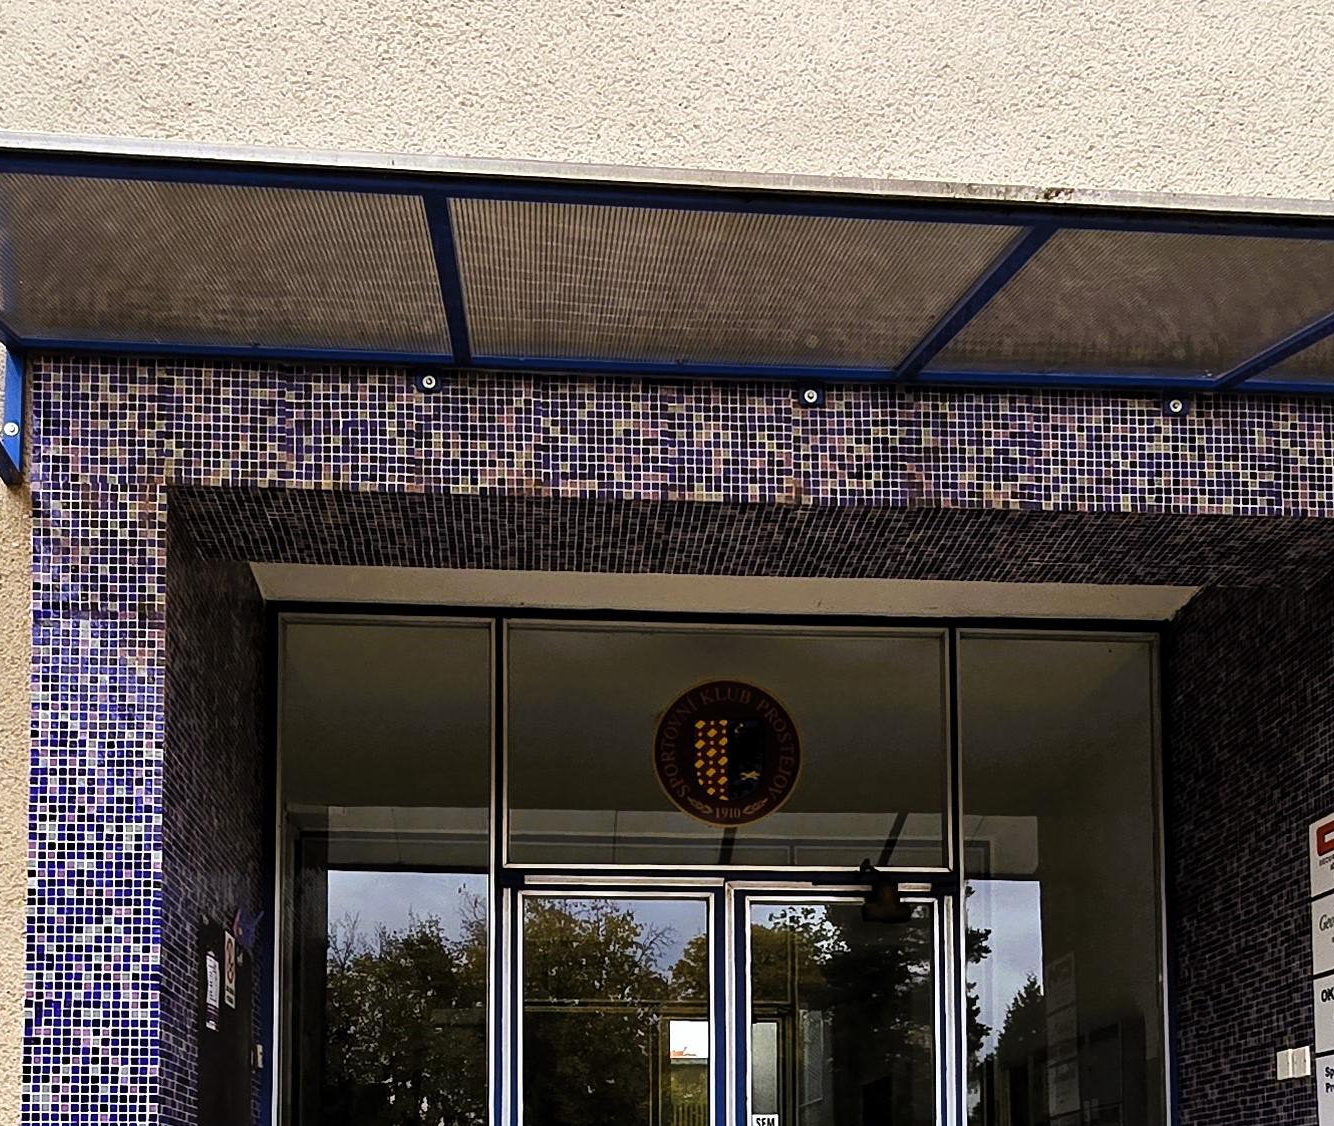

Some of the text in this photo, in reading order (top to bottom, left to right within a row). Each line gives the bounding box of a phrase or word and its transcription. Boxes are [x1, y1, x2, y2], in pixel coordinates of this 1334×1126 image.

[699, 687, 752, 705] KLUB
[715, 807, 742, 819] 1910
[1321, 986, 1334, 1003] OK
